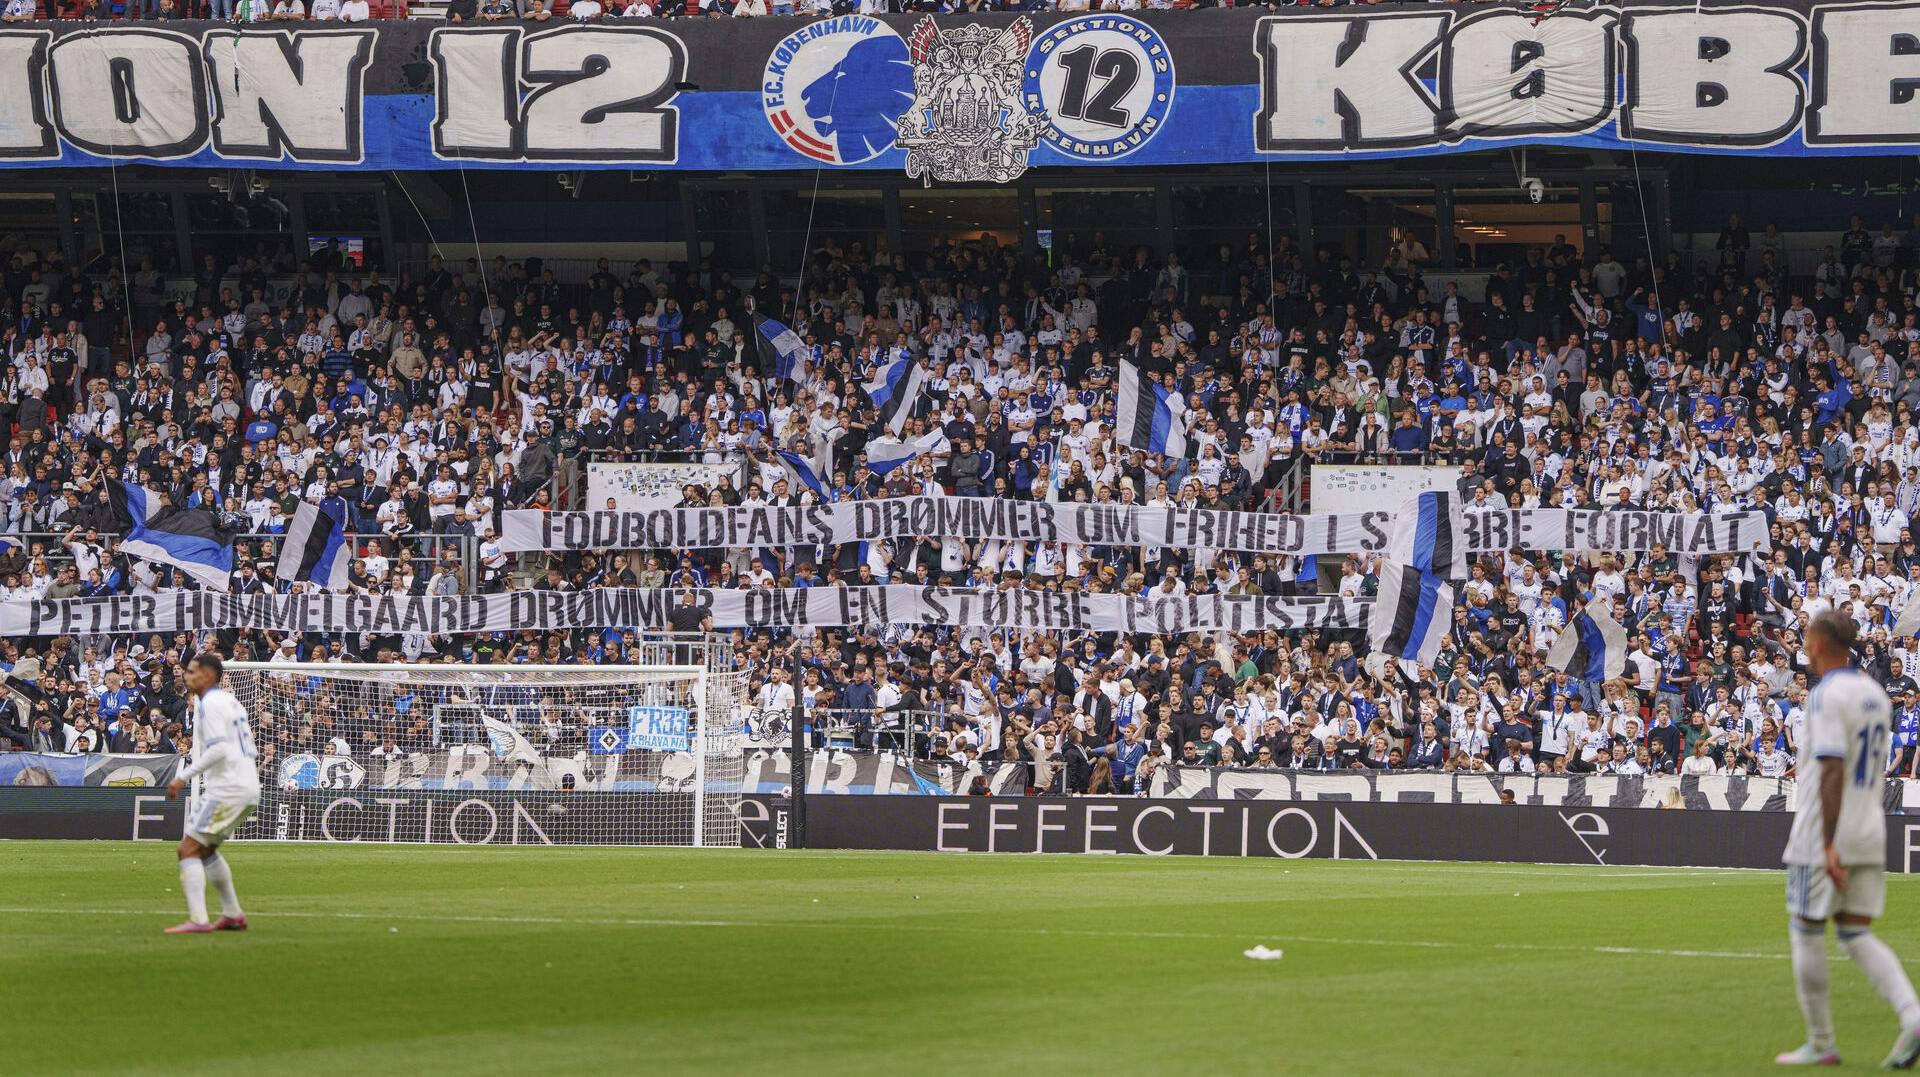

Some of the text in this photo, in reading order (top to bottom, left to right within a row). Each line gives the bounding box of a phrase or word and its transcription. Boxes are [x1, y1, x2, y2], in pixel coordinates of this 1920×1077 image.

[1039, 19, 1168, 73] SEKTION 12
[1058, 44, 1141, 128] 12
[1026, 92, 1159, 156] KBENHAVN
[542, 497, 1751, 553] FODBOLDFANS DRØMMER OM FRIHED I SRRE FORMAT
[29, 595, 157, 635] PETER
[175, 592, 489, 634] HUMMELGAARD
[745, 588, 808, 627] OM
[839, 586, 889, 625] EN
[921, 585, 1092, 629] STØRRE
[1127, 593, 1377, 634] POLITISTAT
[631, 707, 687, 736] FR33
[776, 810, 788, 849] SELECT
[935, 802, 1378, 860] EFFECTION
